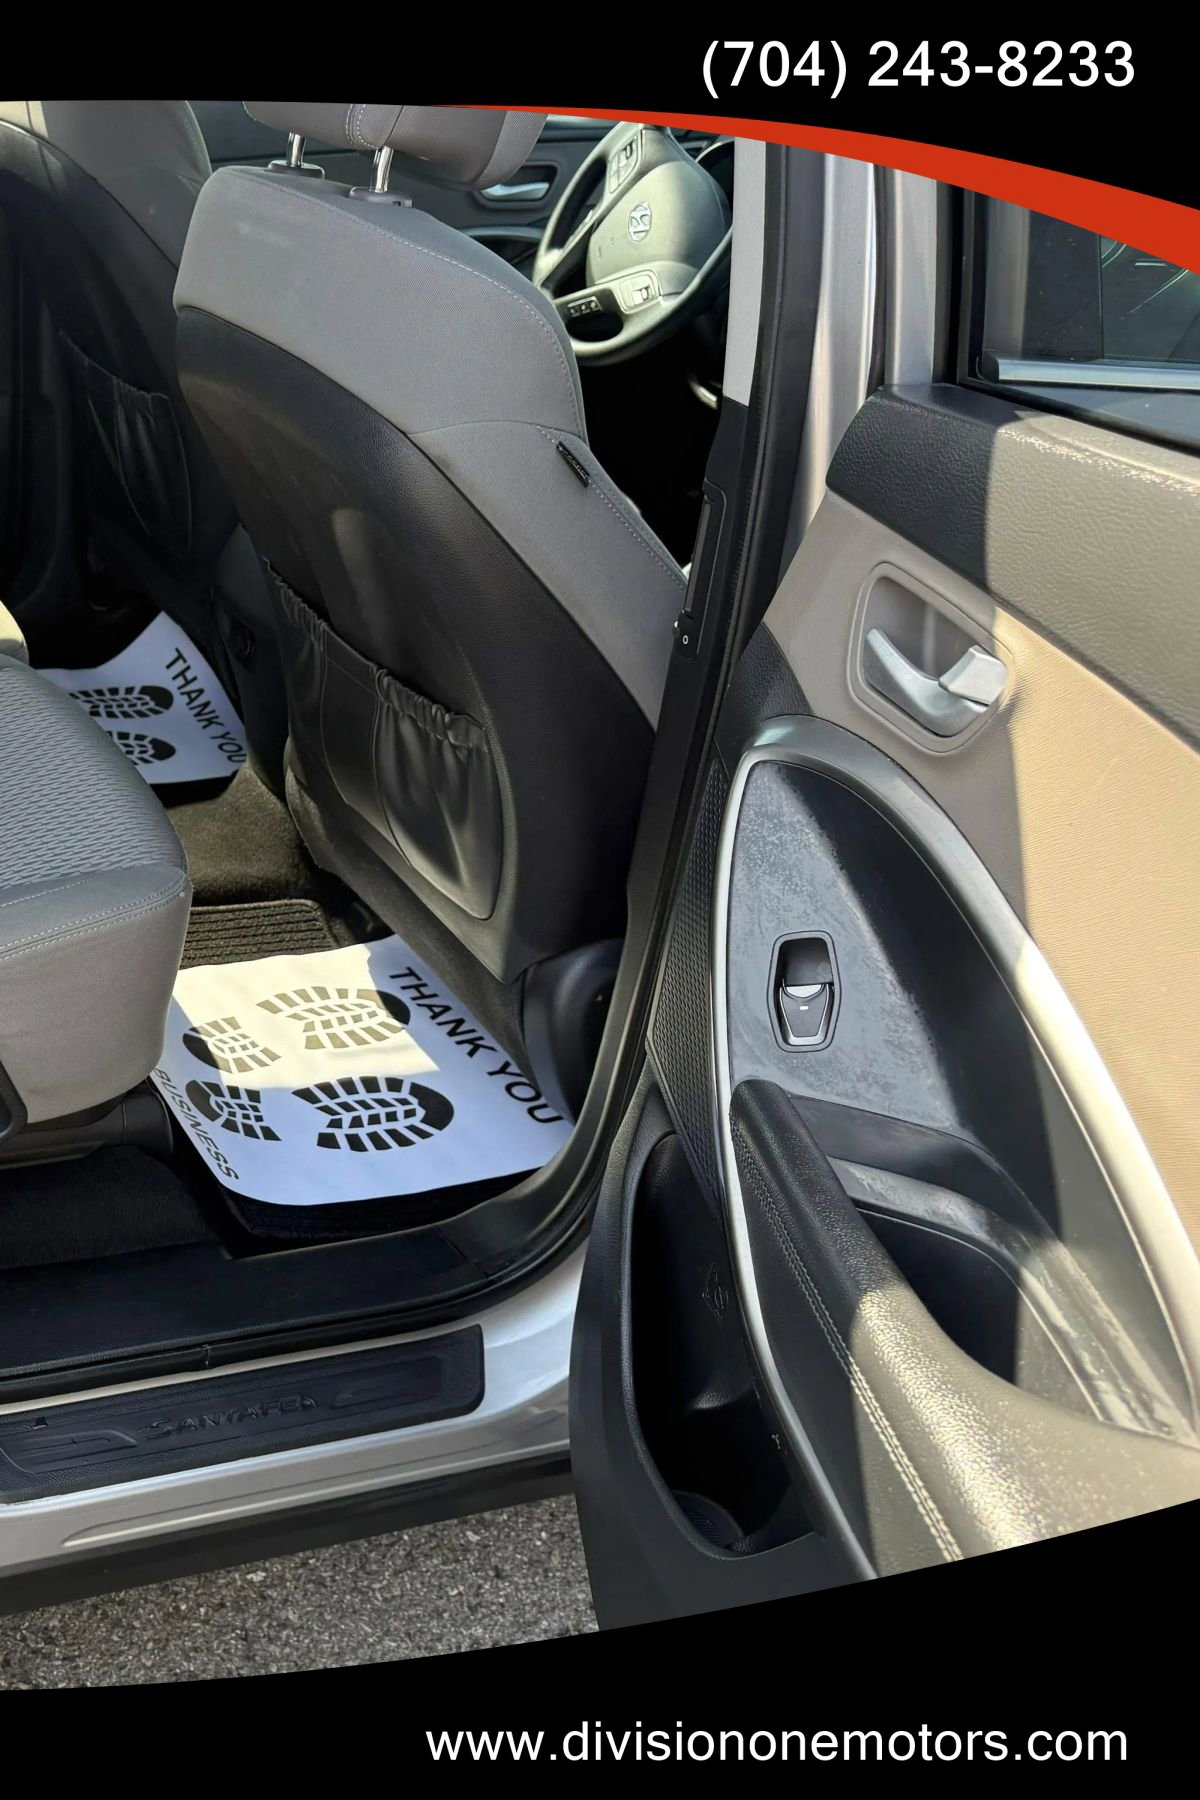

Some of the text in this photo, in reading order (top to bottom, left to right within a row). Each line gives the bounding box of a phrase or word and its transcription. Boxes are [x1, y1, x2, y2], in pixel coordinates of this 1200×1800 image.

[165, 647, 247, 763] THANK YOU
[388, 966, 566, 1124] THANK YOU
[153, 1067, 239, 1180] BUSINESS
